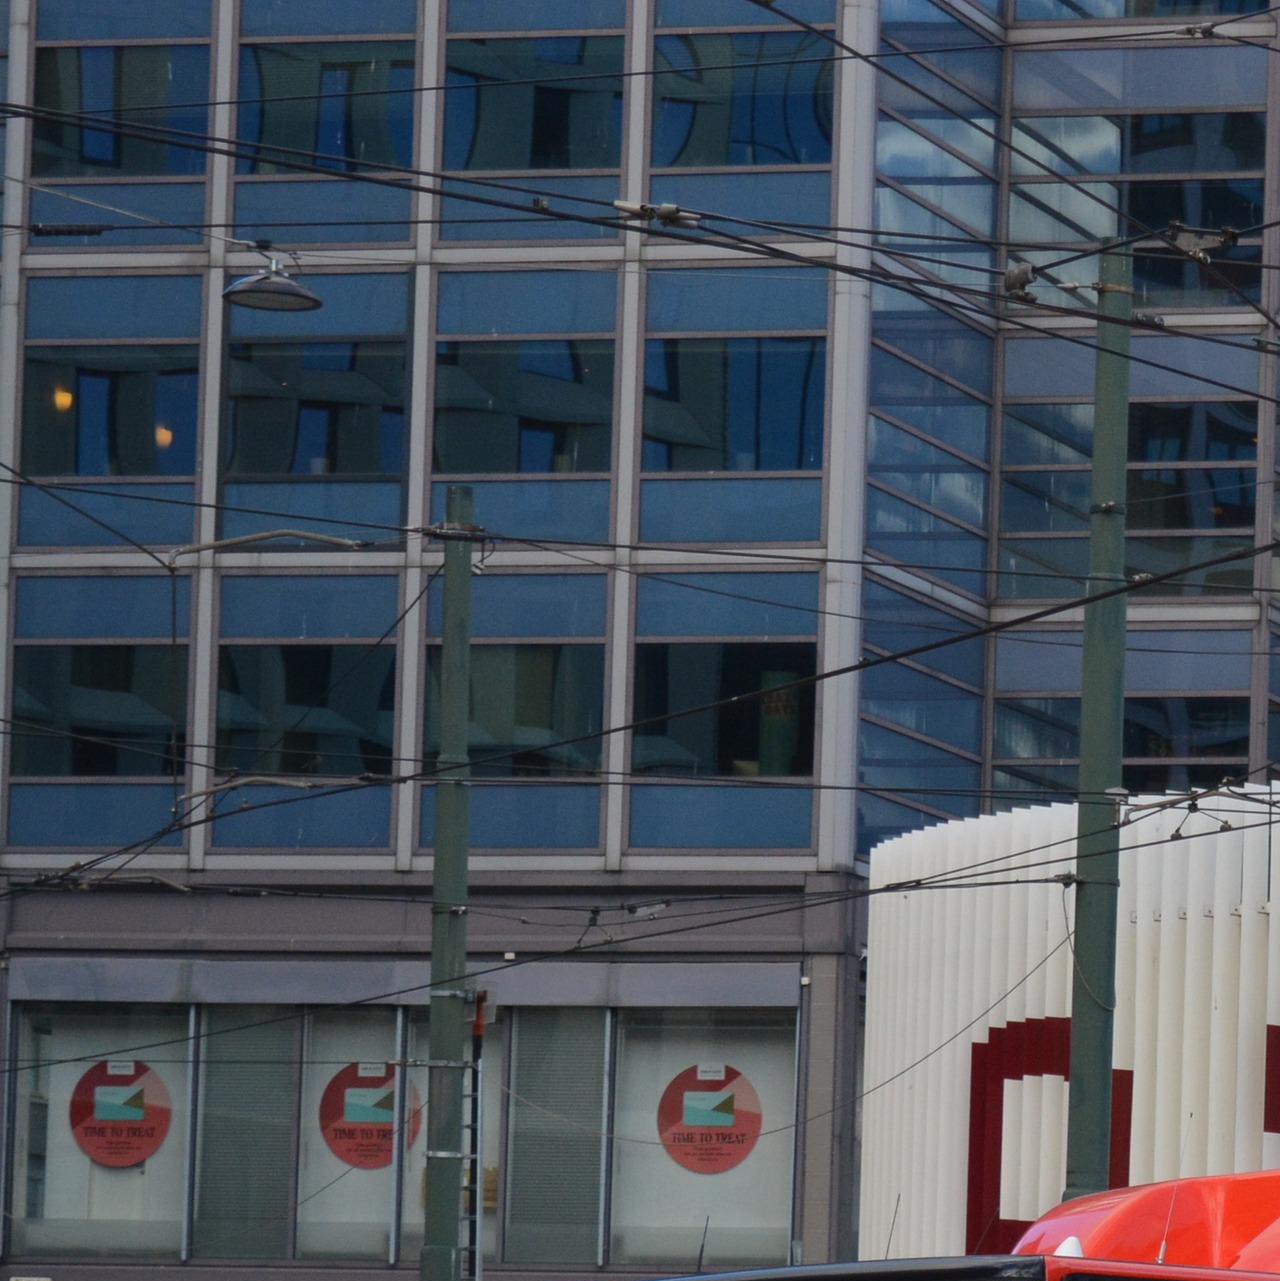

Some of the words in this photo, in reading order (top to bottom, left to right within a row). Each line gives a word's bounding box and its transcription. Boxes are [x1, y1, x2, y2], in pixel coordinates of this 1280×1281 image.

[111, 1127, 123, 1138] TO
[361, 1129, 373, 1140] TO
[376, 1129, 394, 1140] TRE
[700, 1132, 712, 1144] TO
